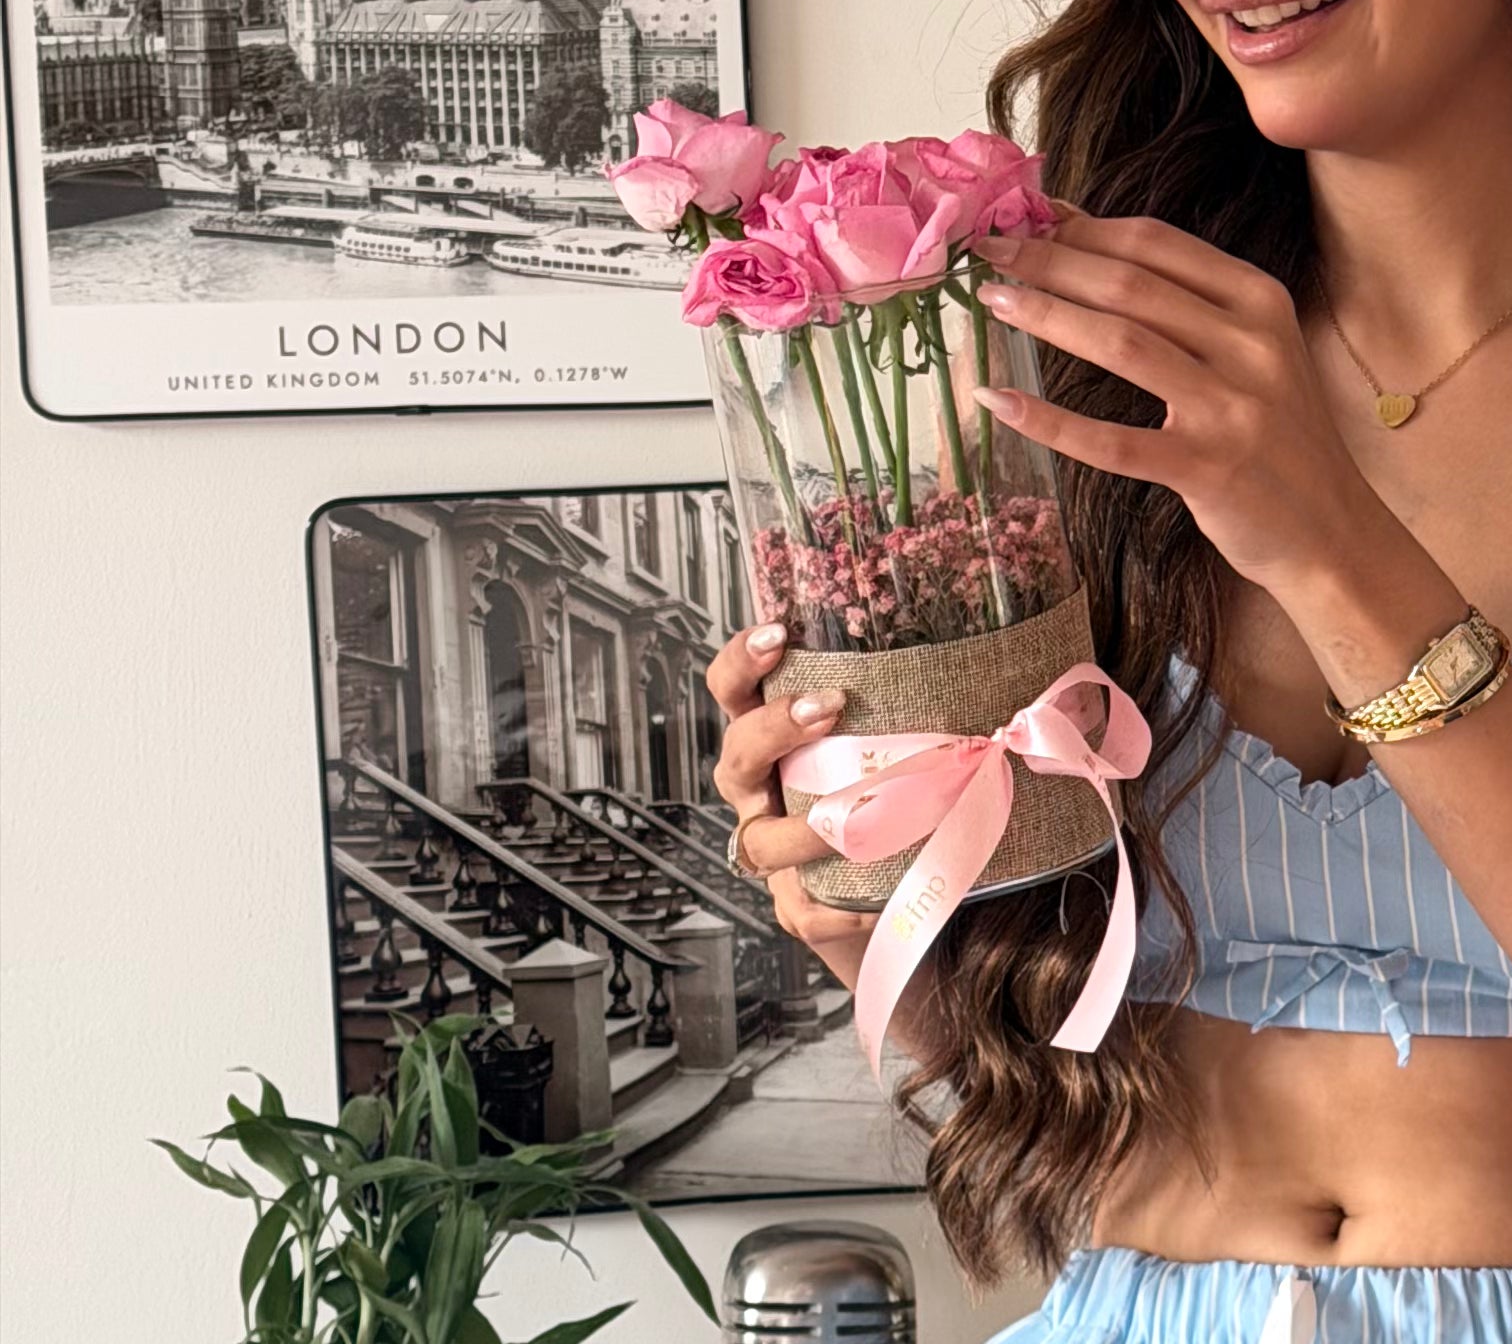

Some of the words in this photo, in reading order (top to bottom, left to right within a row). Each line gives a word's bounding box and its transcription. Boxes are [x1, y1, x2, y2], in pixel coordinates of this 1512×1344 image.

[279, 320, 507, 357] LONDON
[167, 374, 254, 391] UNITED
[266, 371, 380, 389] KINGDOM
